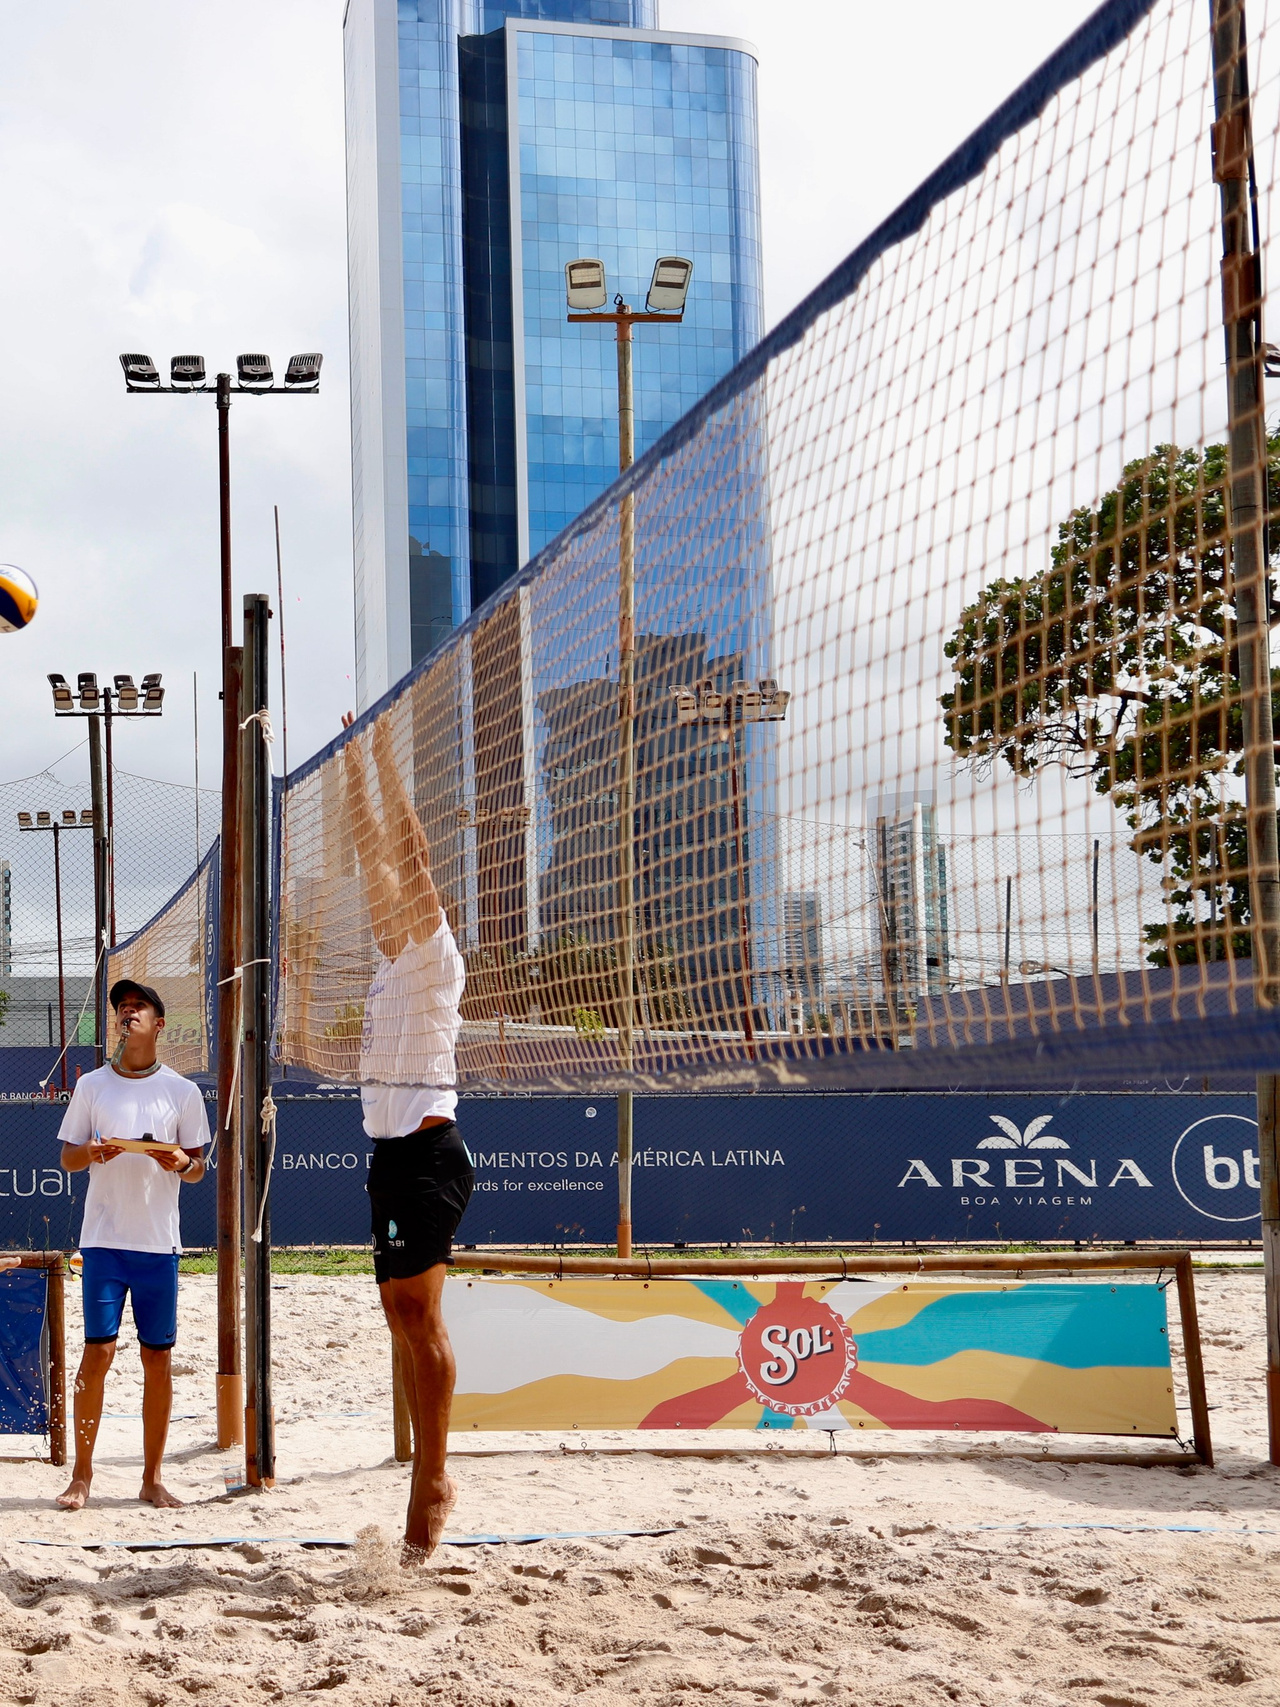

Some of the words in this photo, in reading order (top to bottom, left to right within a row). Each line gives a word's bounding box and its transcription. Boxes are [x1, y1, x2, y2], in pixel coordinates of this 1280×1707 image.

[283, 1153, 358, 1169] BANCO
[575, 1152, 603, 1168] DA
[712, 1150, 785, 1166] LATINA
[1203, 1145, 1261, 1190] bt
[897, 1159, 1154, 1187] ARENA
[503, 1180, 523, 1191] for
[528, 1179, 604, 1191] excellence
[961, 1197, 1000, 1206] BOA
[1014, 1196, 1093, 1206] VIAGEM
